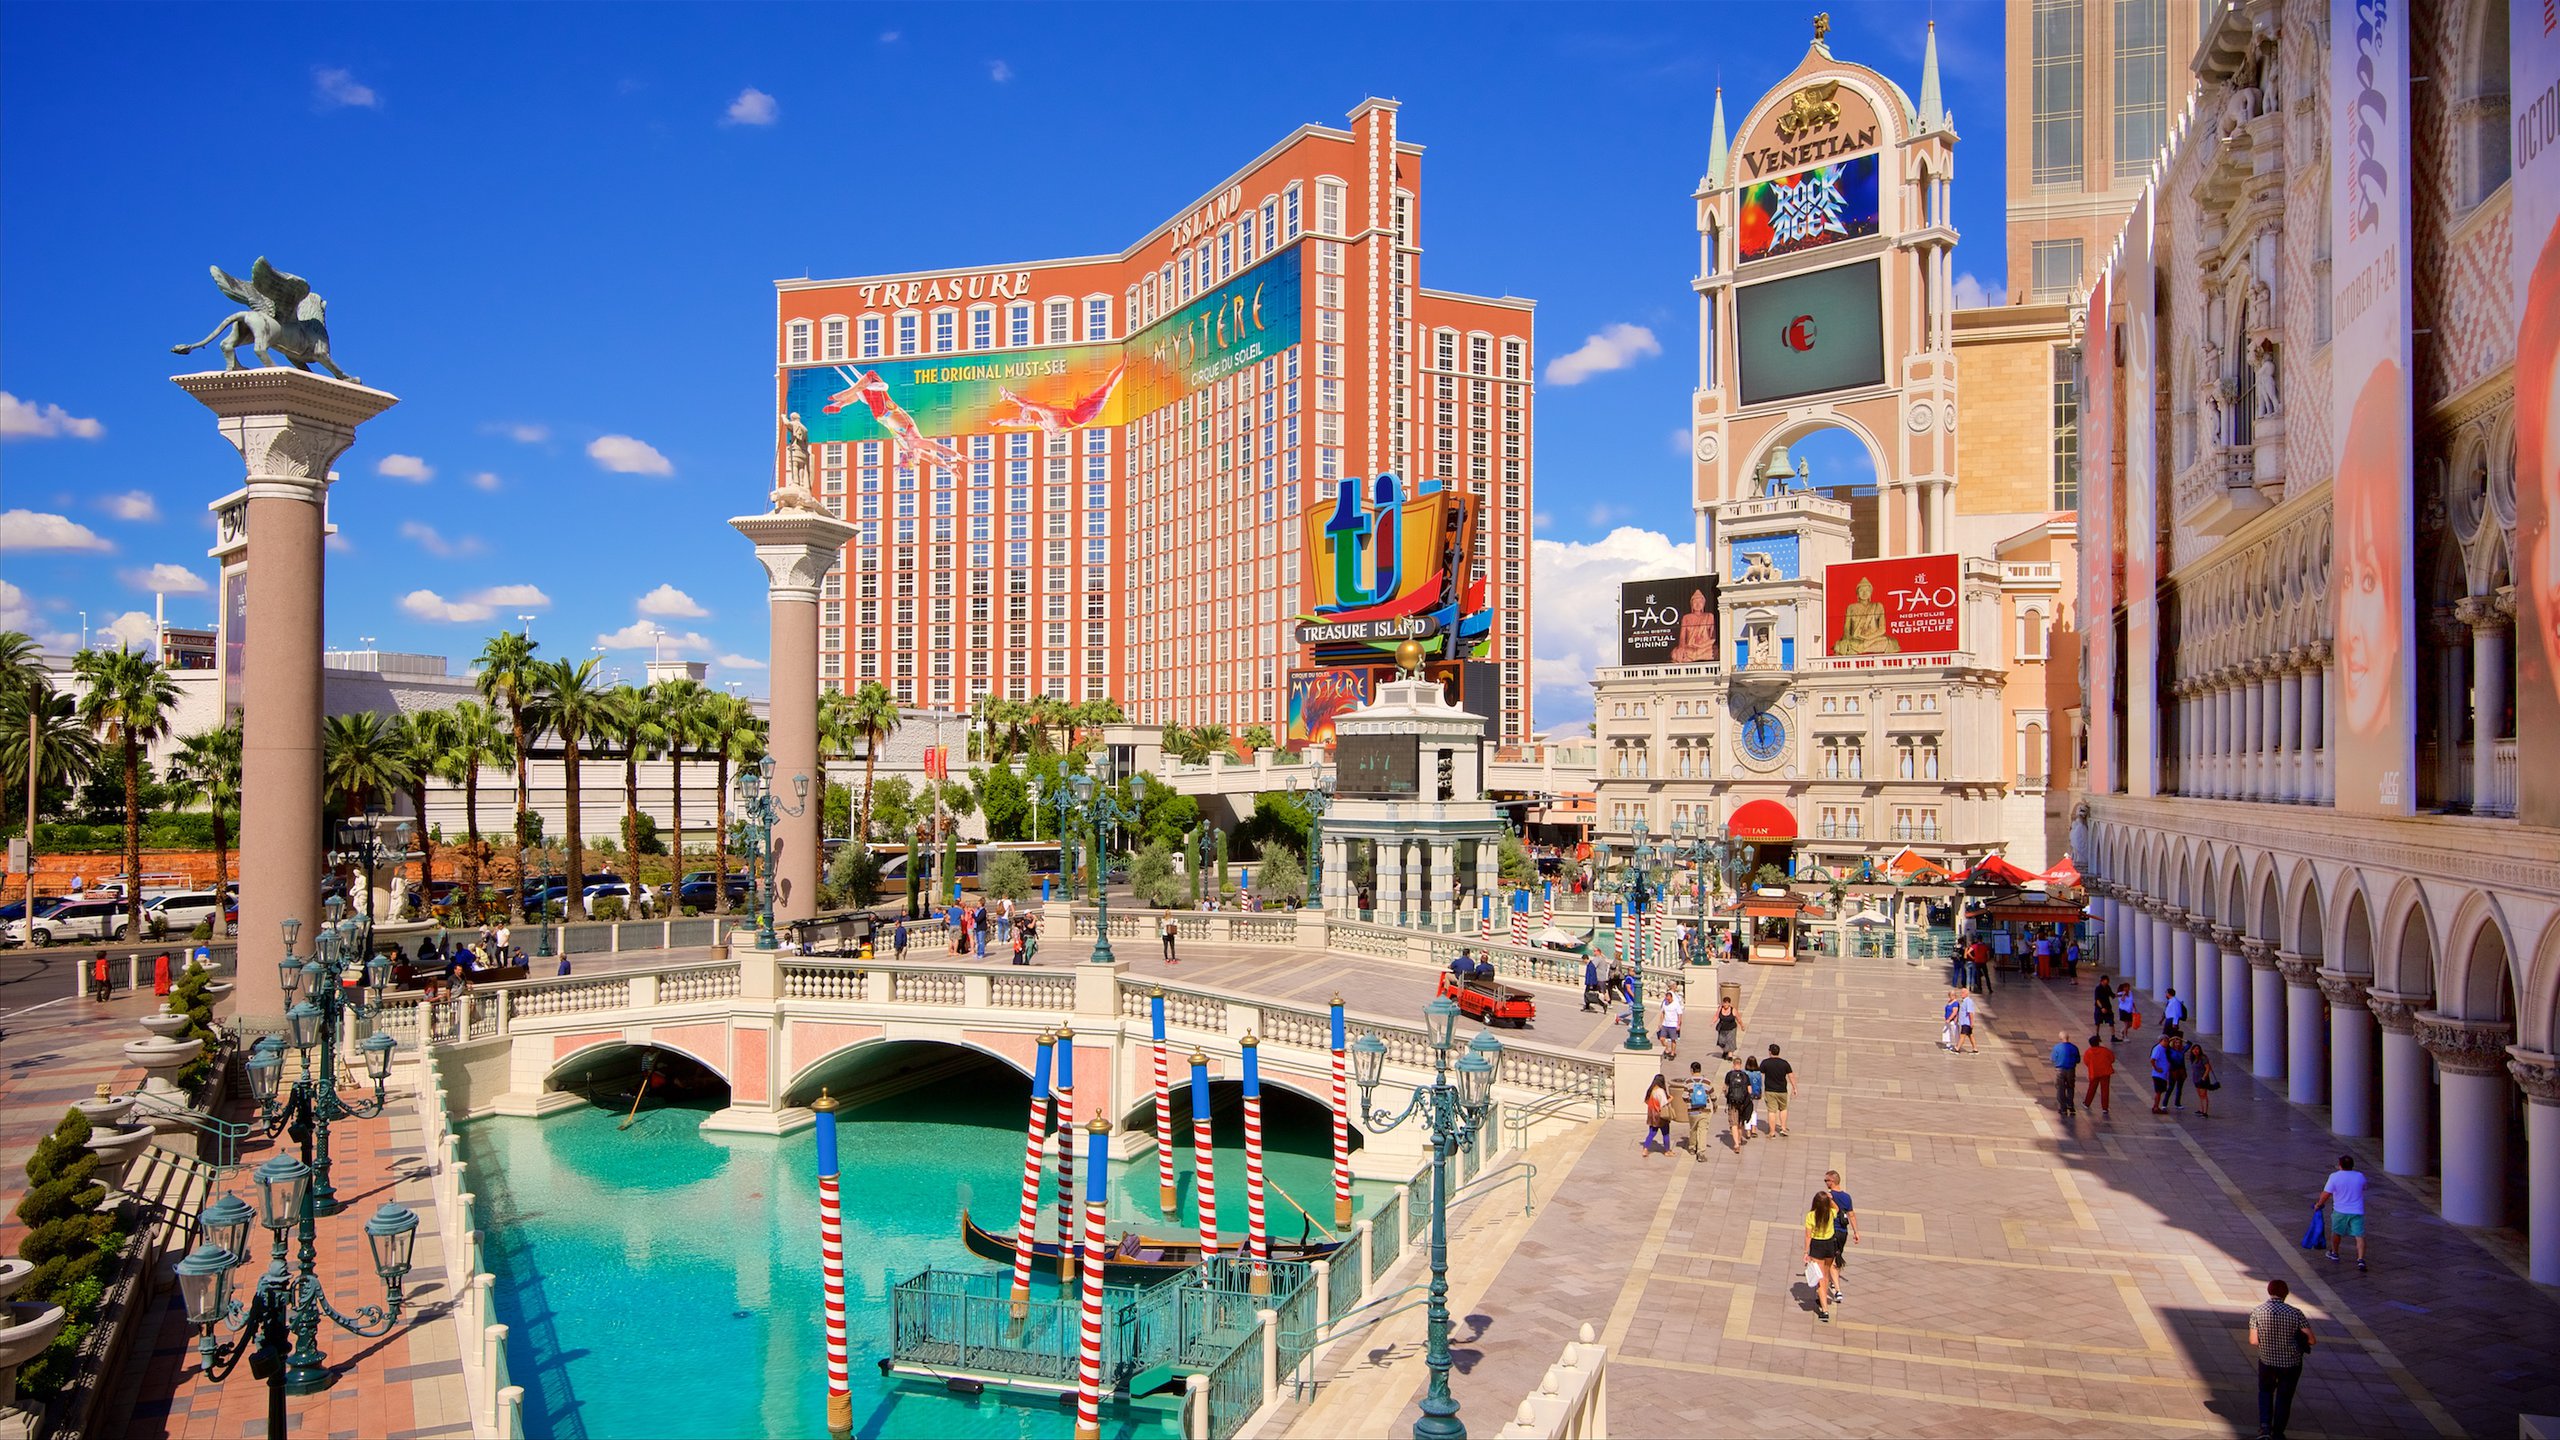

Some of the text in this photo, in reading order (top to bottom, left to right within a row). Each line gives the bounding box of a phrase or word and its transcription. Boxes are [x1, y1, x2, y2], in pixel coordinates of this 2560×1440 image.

[1743, 125, 1876, 179] VENETIAN
[2347, 150, 2357, 205] night
[1768, 163, 1848, 224] ROCK
[1800, 202, 1813, 213] OF
[1171, 184, 1242, 253] ISLAND
[1768, 202, 1848, 253] AGES
[2348, 209, 2357, 244] out
[859, 272, 1031, 309] TREASURE
[2335, 243, 2396, 336] OCTOBER 7-24
[914, 359, 1067, 384] THE ORIGINAL MUST-SEE
[1191, 341, 1263, 386] CIRQUE DU SOLEIL
[1887, 586, 1956, 612] TAO
[1624, 606, 1679, 628] TAO
[1890, 618, 1954, 628] RELIGIOUS
[1892, 625, 1952, 634] NIGHTLIFE
[1303, 624, 1367, 642] TREASURE
[1628, 635, 1676, 643] SPIRITUAL
[1635, 641, 1668, 649] DINING
